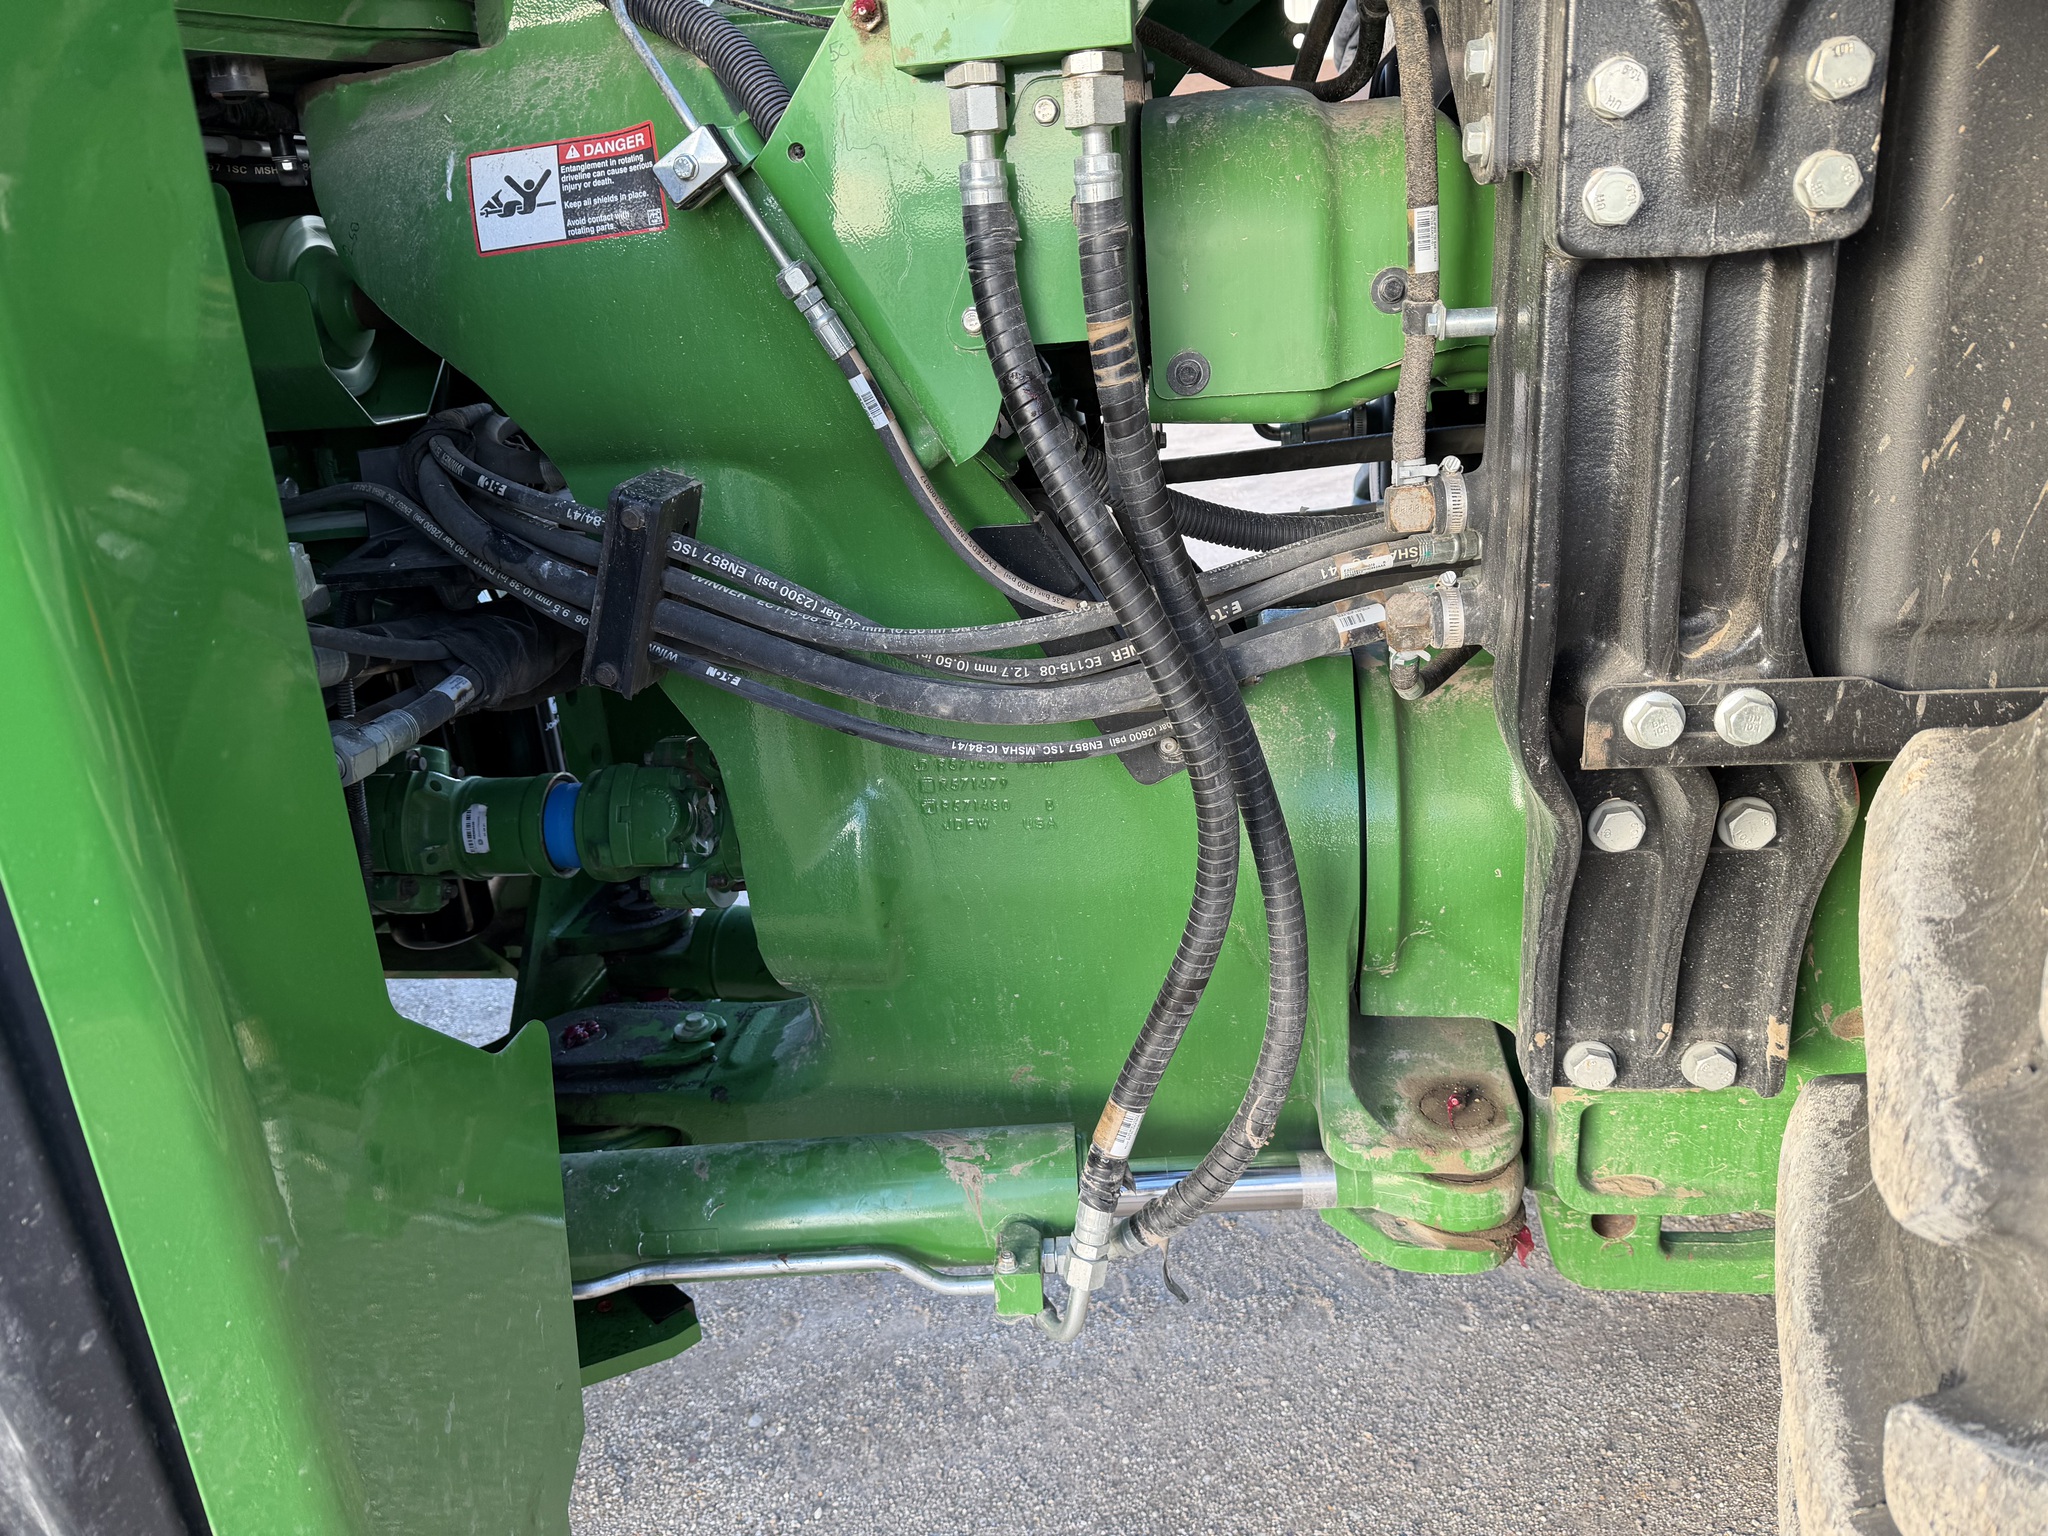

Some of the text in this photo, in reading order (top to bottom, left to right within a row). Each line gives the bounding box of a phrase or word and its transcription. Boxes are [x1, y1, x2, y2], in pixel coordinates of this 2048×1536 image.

[584, 132, 645, 157] DANGER
[227, 164, 248, 174] 1SC
[560, 153, 644, 174] Entanglement in rotating
[561, 161, 653, 183] driveline can cause serious
[562, 177, 615, 193] injury or death.
[564, 190, 649, 209] Keep all shields in place.
[566, 210, 630, 227] Avoid contact with
[567, 225, 595, 236] rotating
[412, 512, 426, 525] psi)
[949, 519, 969, 542] EN857
[442, 535, 456, 548] bar
[454, 544, 469, 558] 180
[967, 540, 998, 571] EXCEEDS
[671, 540, 842, 622] bar (2300 psi) EN857 1SC
[534, 594, 553, 607] mm
[552, 604, 571, 617] 9.5
[935, 655, 970, 673] (0.50
[974, 663, 998, 674] mm
[1039, 655, 1102, 677] EC115-08
[1001, 666, 1030, 678] 12.7
[1129, 725, 1157, 742] (2600
[951, 741, 998, 754] IC-84/41
[1068, 740, 1103, 753] EN857
[1109, 735, 1127, 747] psi)
[1001, 745, 1036, 756] MSHA
[1042, 744, 1065, 755] 1SC
[1022, 816, 1058, 831] USA
